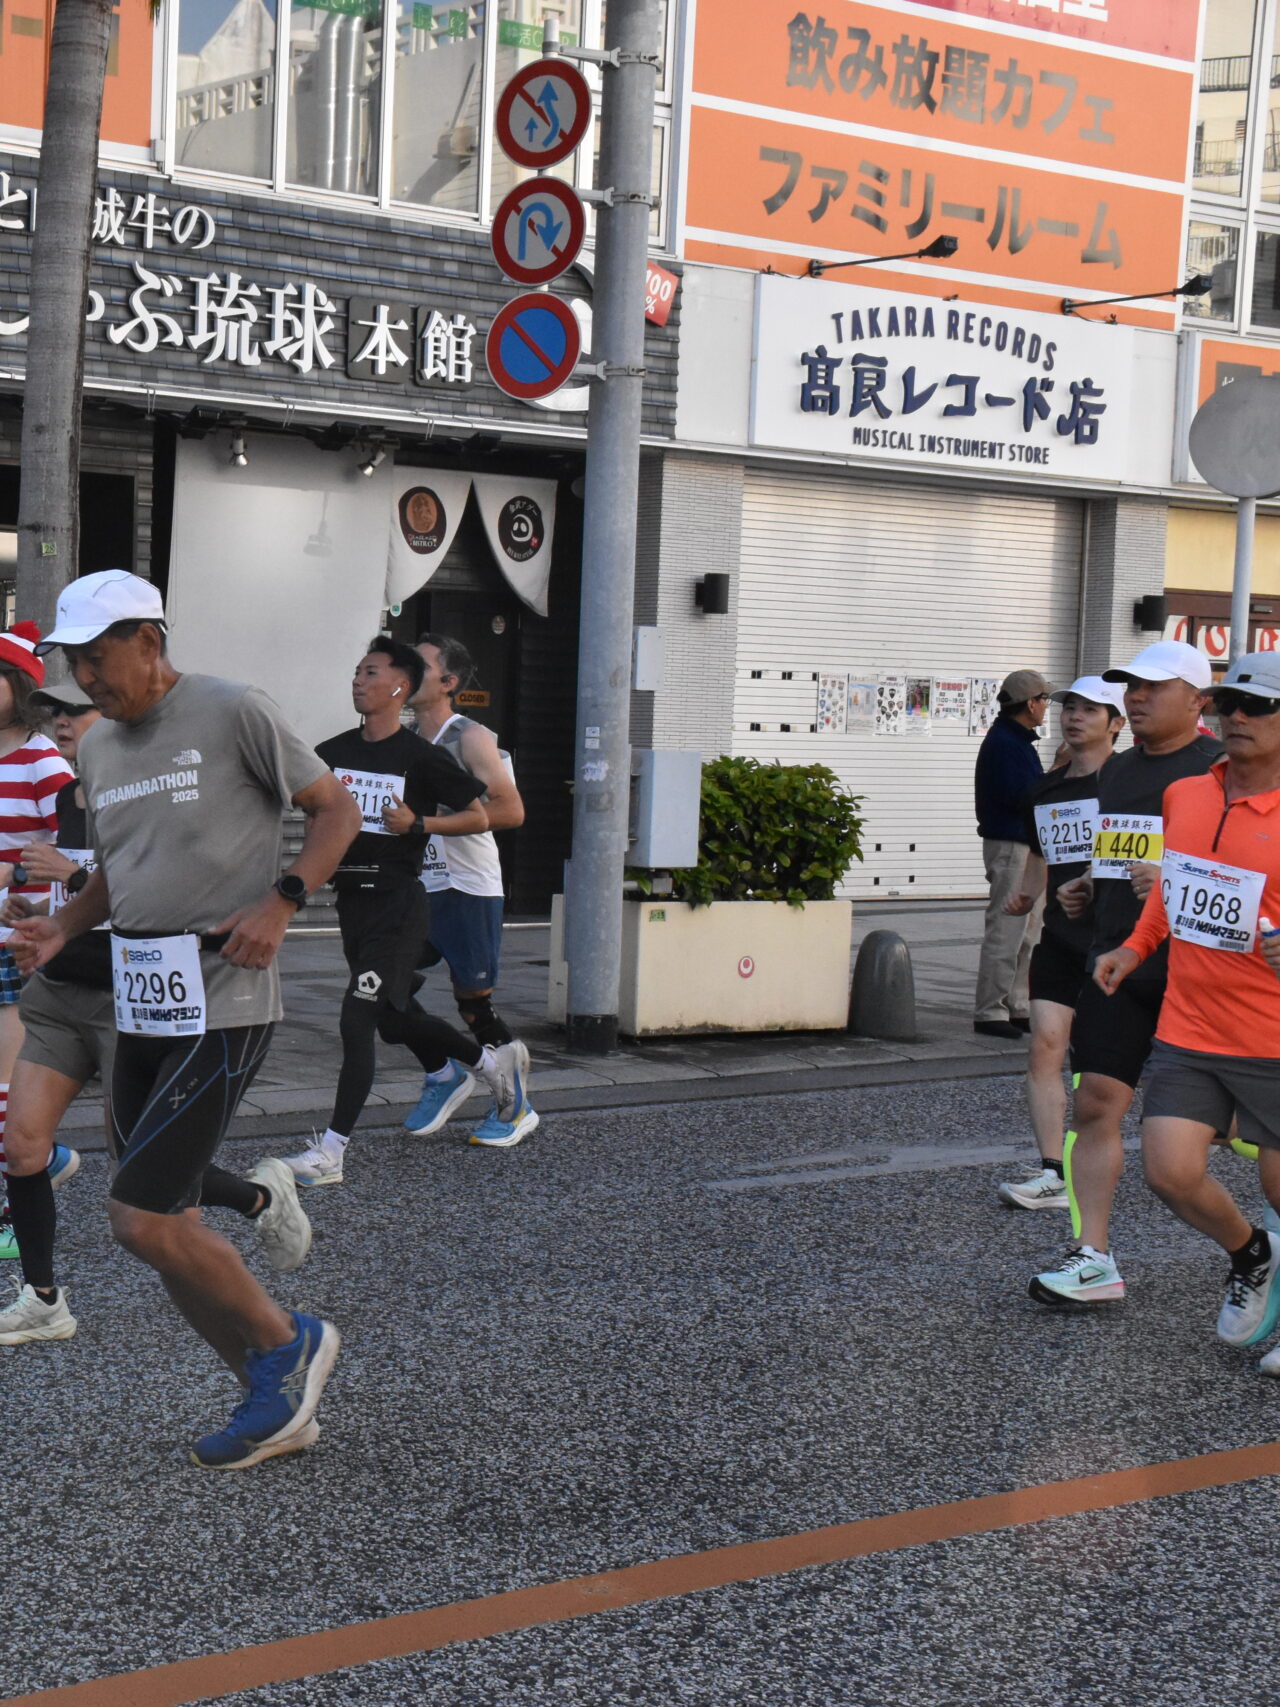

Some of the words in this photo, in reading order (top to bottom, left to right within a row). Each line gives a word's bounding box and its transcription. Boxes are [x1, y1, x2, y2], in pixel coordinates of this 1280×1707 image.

[785, 12, 1115, 146] 飲み放題カフェ
[759, 145, 1124, 270] ファミリールーム
[353, 305, 476, 383] 本館
[832, 305, 935, 344] TAKARA
[947, 309, 1058, 371] RECORDS
[853, 427, 915, 452] MUSICAL
[919, 434, 1005, 461] INSTRUMENT
[1008, 443, 1050, 465] STORE
[96, 769, 199, 809] ULTRAMARATHON
[171, 789, 199, 803] 2025
[1057, 807, 1081, 817] sato
[1040, 826, 1048, 846] C
[1051, 820, 1093, 845] 2215
[1093, 833, 1102, 858] A
[1109, 832, 1150, 859] 440
[1162, 878, 1172, 906] C
[1180, 884, 1242, 925] 1968
[128, 950, 163, 962] sato
[124, 970, 187, 1005] 2296
